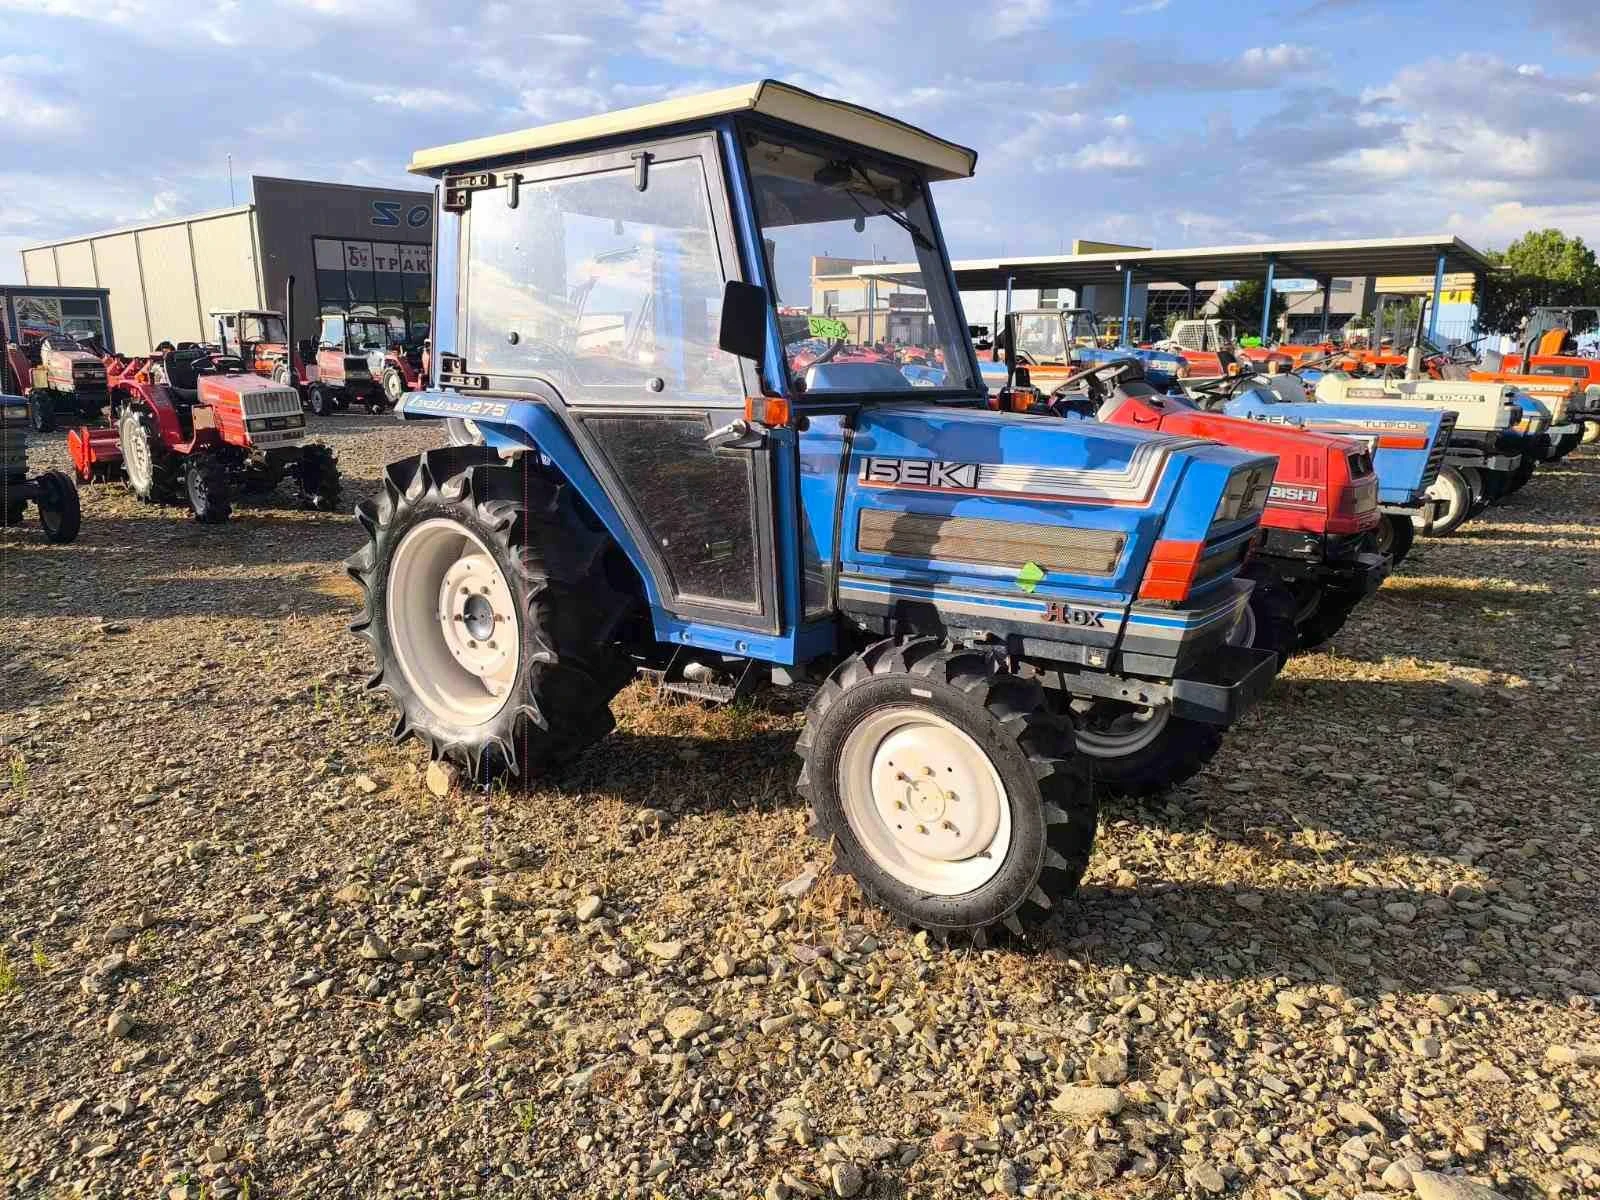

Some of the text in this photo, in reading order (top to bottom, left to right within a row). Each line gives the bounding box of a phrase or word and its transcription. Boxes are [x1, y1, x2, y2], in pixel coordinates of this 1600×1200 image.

[375, 257, 432, 272] ТРАК
[860, 458, 979, 488] ISEKI
[1269, 486, 1319, 502] BISHI
